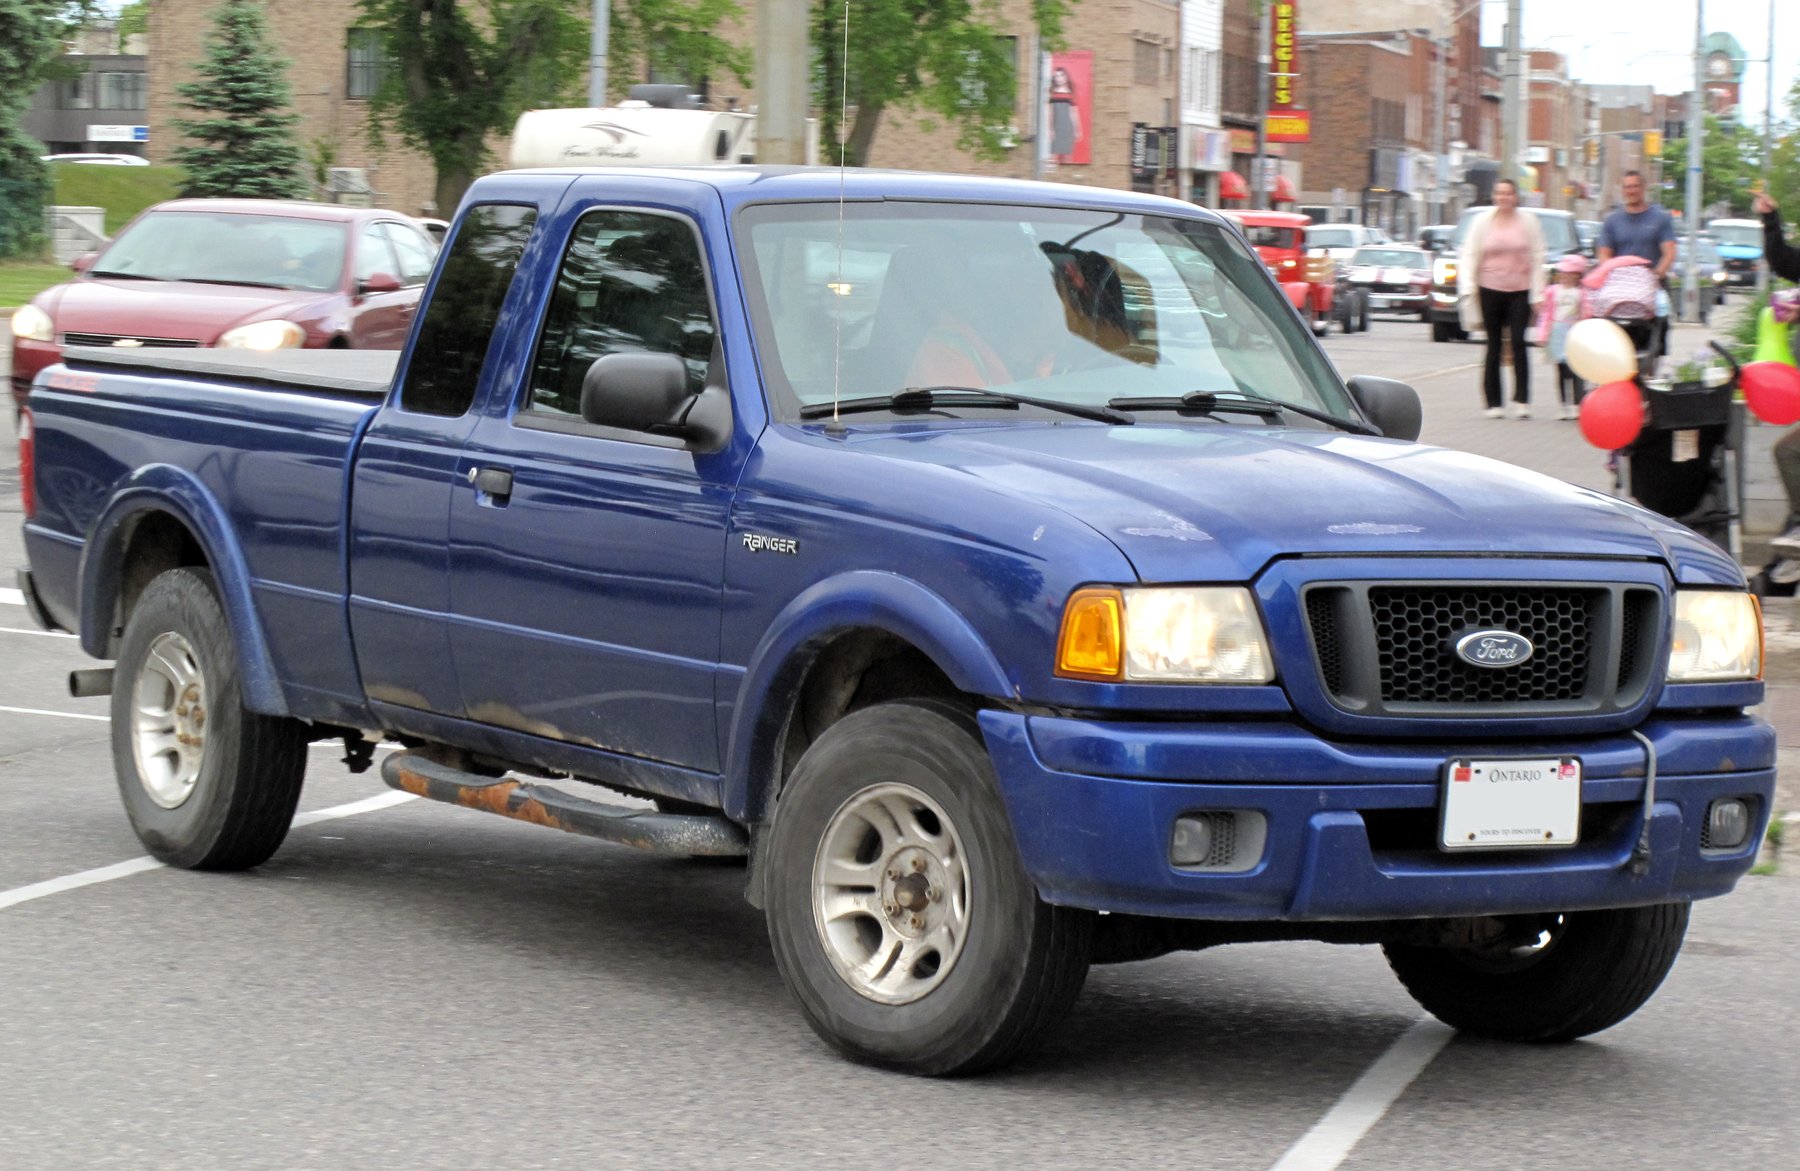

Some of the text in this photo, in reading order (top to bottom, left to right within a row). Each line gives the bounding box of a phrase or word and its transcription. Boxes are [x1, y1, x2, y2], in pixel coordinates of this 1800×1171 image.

[743, 533, 797, 554] RANGER
[1476, 637, 1518, 659] Ford
[1489, 769, 1541, 783] ONTARIO
